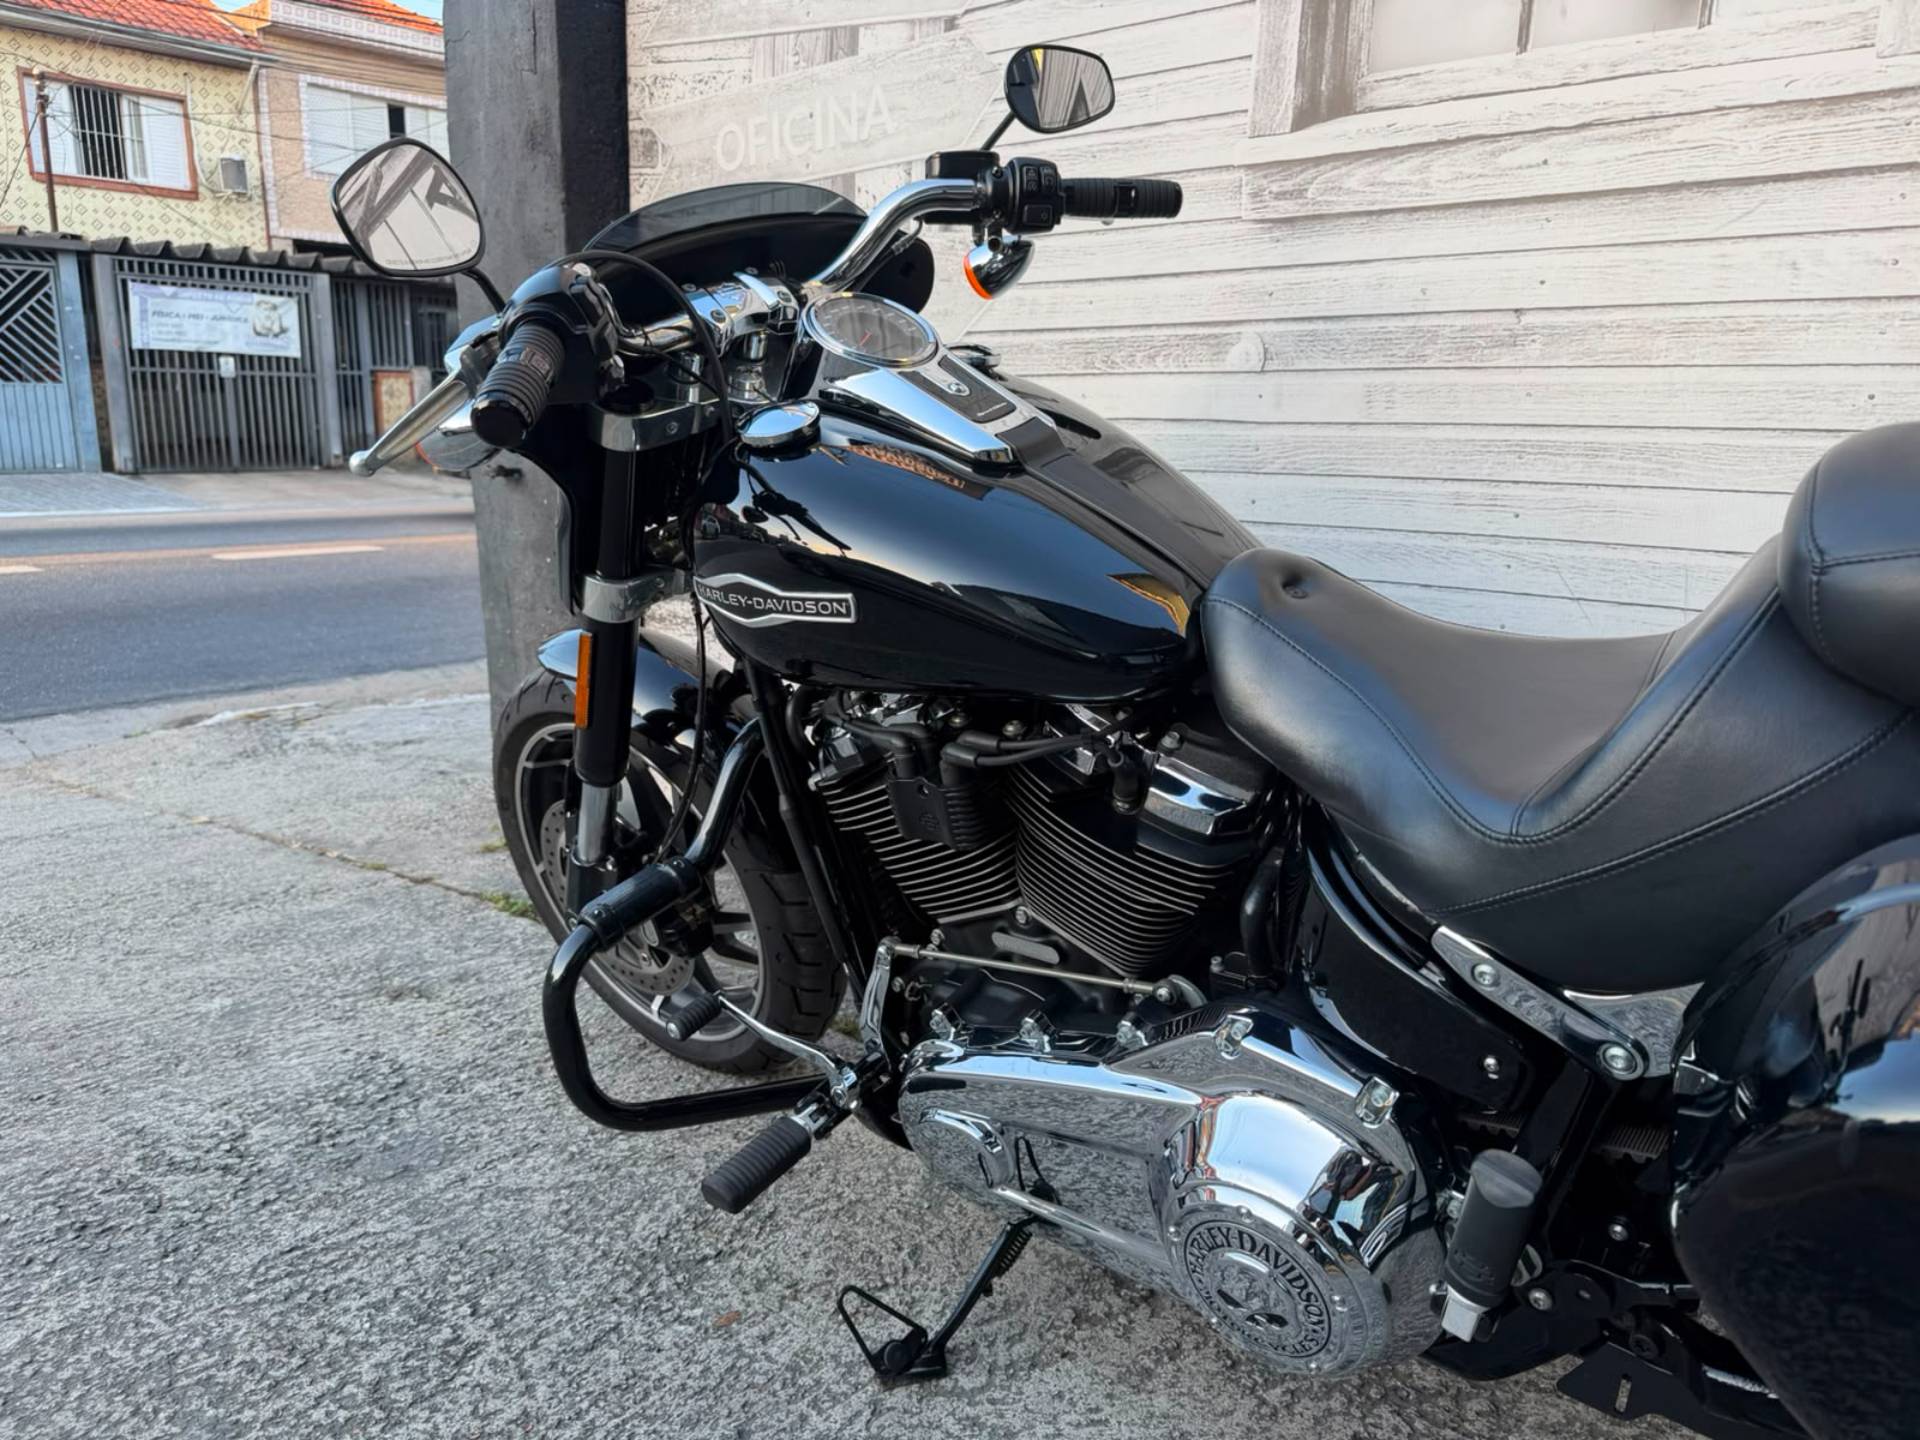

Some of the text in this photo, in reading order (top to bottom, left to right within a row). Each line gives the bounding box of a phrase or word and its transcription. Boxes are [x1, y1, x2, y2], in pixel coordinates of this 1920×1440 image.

[717, 85, 896, 172] OFICINA
[698, 585, 847, 614] HARLEY-DAVIDSON
[1188, 1226, 1325, 1331] HARLEY-DAVIDSON
